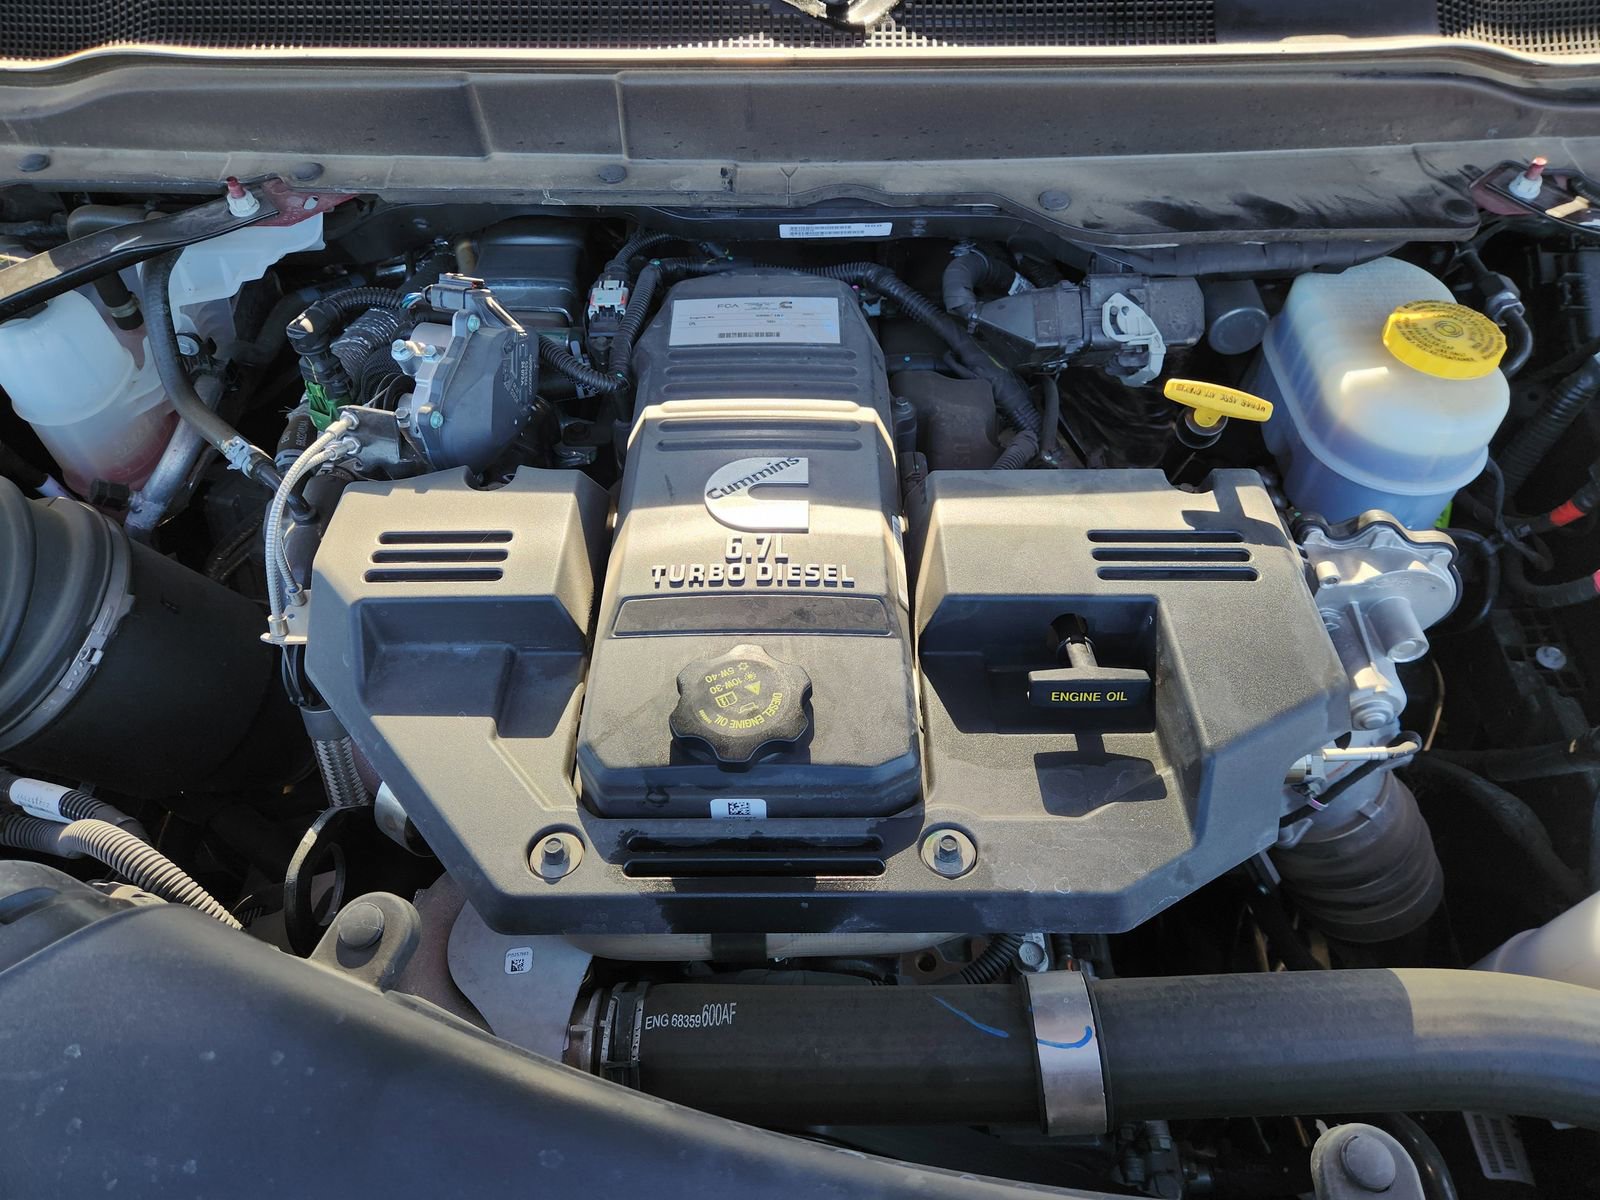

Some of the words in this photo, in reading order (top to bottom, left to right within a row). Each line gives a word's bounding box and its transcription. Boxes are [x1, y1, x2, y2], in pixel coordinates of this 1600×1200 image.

[706, 456, 800, 500] Cummins
[725, 535, 789, 564] 6.7L
[651, 563, 746, 588] TURBO
[756, 563, 855, 588] DIESEL
[704, 667, 735, 683] 5W-40
[709, 677, 743, 695] 10W-30
[761, 692, 783, 717] DIESEL
[1051, 691, 1102, 702] ENGINE
[1106, 691, 1128, 702] OIL
[714, 714, 729, 727] OIL
[729, 714, 765, 729] ENGINE
[645, 1013, 669, 1030] ENG
